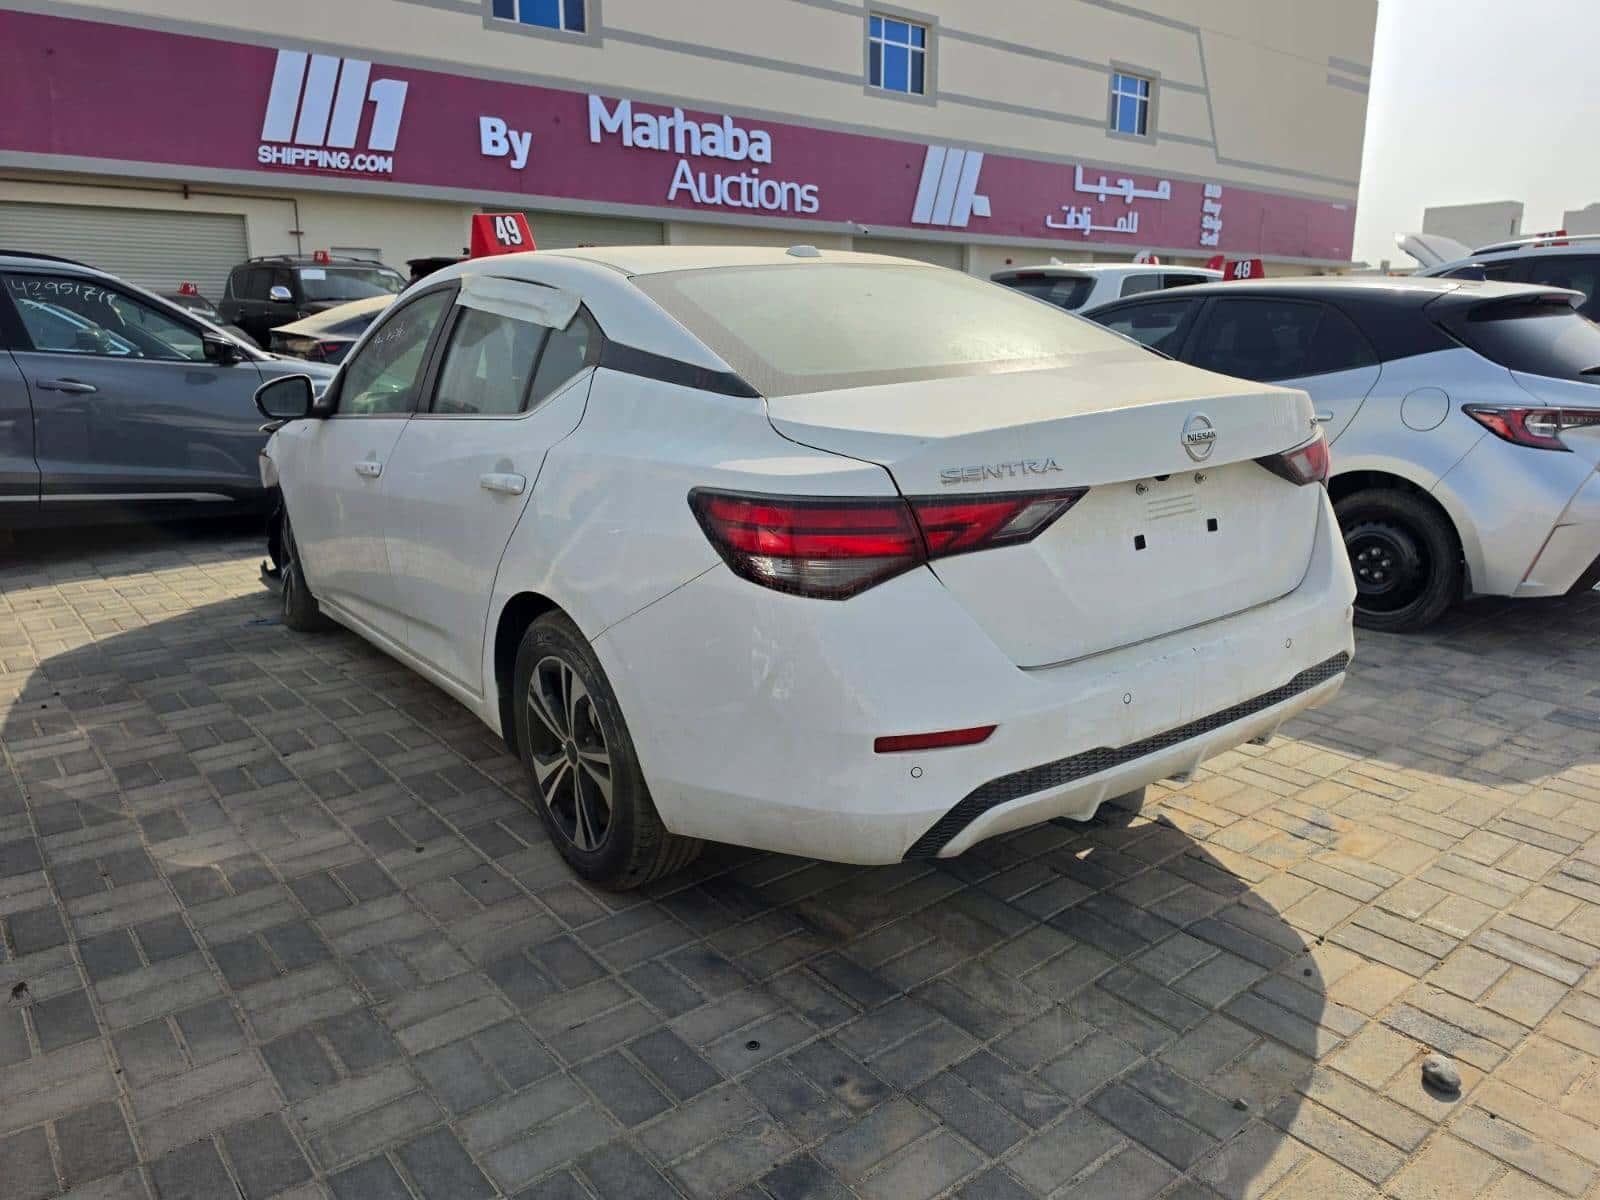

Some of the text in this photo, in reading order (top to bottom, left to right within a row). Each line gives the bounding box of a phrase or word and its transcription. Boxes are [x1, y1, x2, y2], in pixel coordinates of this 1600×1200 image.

[480, 116, 532, 169] By
[588, 94, 772, 164] Marhaba
[257, 145, 393, 173] SHIPPING.COM
[667, 159, 819, 213] Auctions
[495, 215, 522, 246] 49
[1234, 260, 1252, 279] 48
[1187, 430, 1216, 442] NISSAN
[940, 457, 1064, 484] SENTRA
